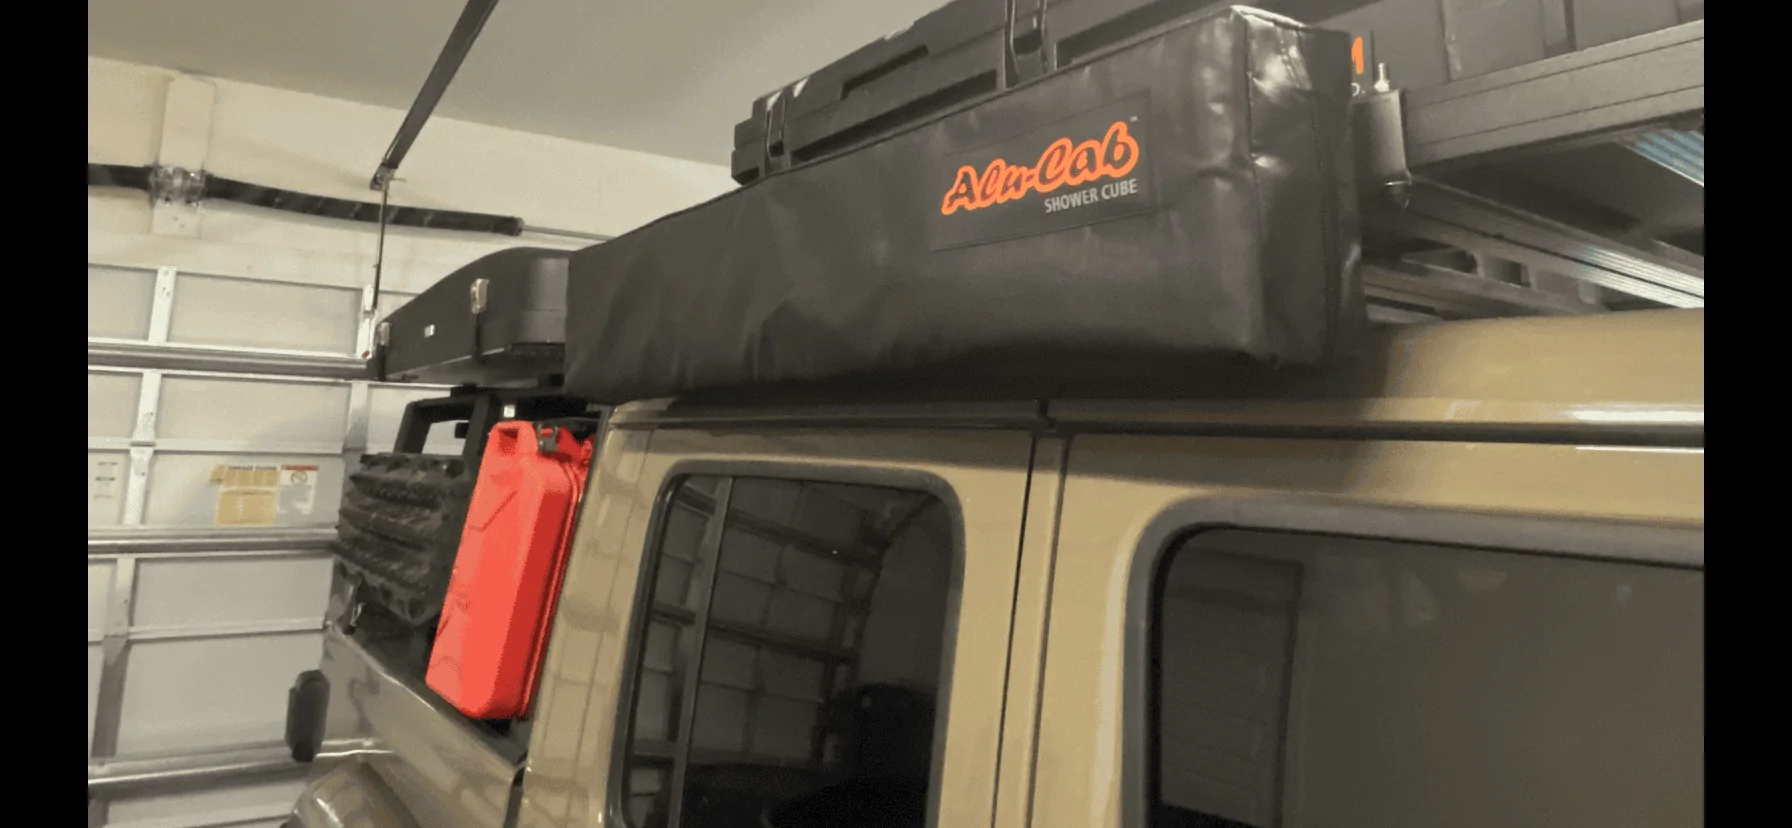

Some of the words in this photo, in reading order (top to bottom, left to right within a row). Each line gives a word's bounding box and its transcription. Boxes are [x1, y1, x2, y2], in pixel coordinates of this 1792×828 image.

[941, 121, 1139, 215] Alu-Cab
[1043, 187, 1099, 214] SHOWER
[1101, 178, 1138, 200] CUBE
